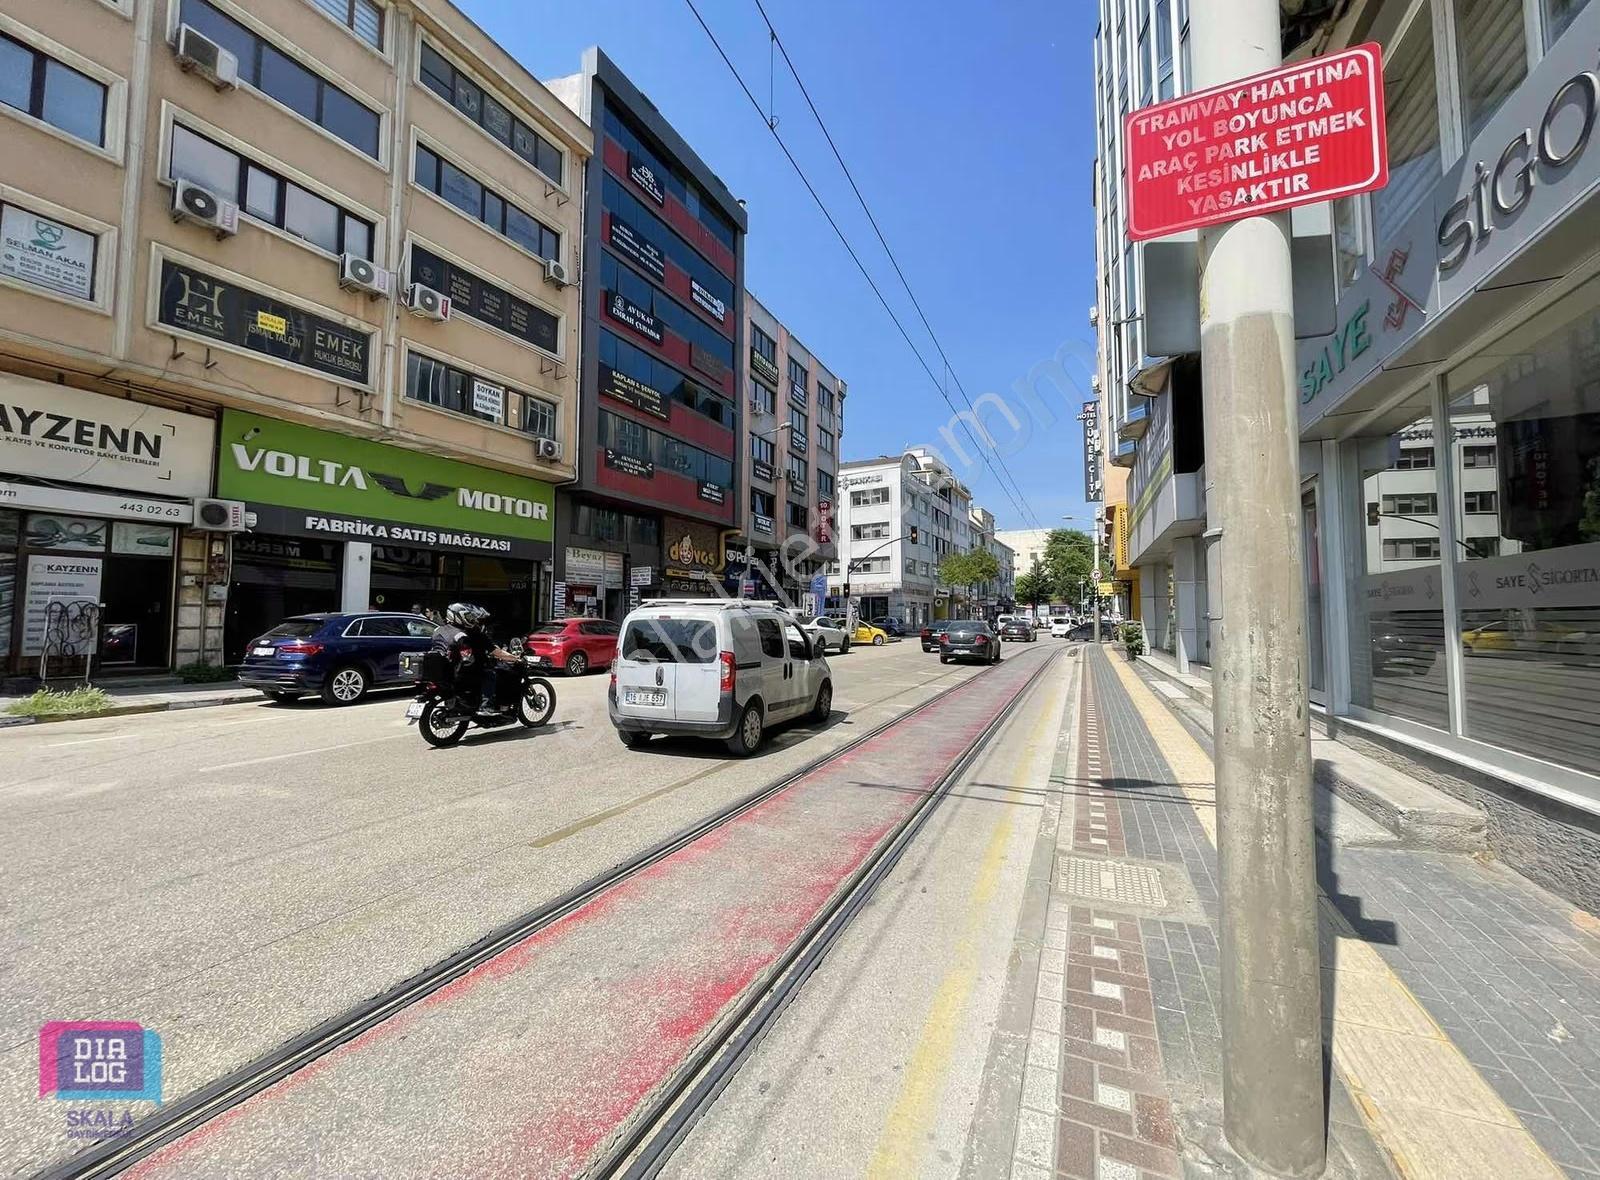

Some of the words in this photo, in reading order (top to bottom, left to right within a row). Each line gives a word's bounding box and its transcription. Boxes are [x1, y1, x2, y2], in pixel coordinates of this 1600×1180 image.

[1136, 91, 1242, 136] TRAMVAY
[1251, 58, 1362, 104] HATTINA
[1162, 131, 1206, 151] YOL
[1213, 92, 1334, 138] BOYUNCA
[1137, 153, 1198, 182] ARAÇ
[1205, 132, 1268, 164] PARK
[1276, 108, 1366, 146] ETMEK
[1177, 145, 1321, 195] KESİNLİKLE
[1187, 173, 1311, 216] YASAKTIR
[6, 237, 54, 259] SELMAN
[56, 255, 87, 269] AKAR
[175, 307, 224, 331] EMEK
[627, 305, 654, 326] AVUKAT
[315, 330, 363, 360] EMEK
[1300, 300, 1370, 404] SAYE
[5, 435, 32, 447] KAYIŞ
[35, 440, 46, 448] VE
[48, 442, 95, 457] KONVEYÖR
[97, 451, 119, 461] BANT
[231, 443, 368, 491] VOLTA
[457, 487, 549, 521] MOTOR
[120, 502, 144, 514] 443
[147, 505, 162, 516] 02
[165, 507, 180, 518] 63
[305, 516, 389, 540] FABRİKA
[390, 526, 438, 547] SATIŞ
[439, 533, 512, 552] MAĞAZASI
[47, 564, 98, 573] KAYZENN
[1496, 575, 1526, 589] SAYE
